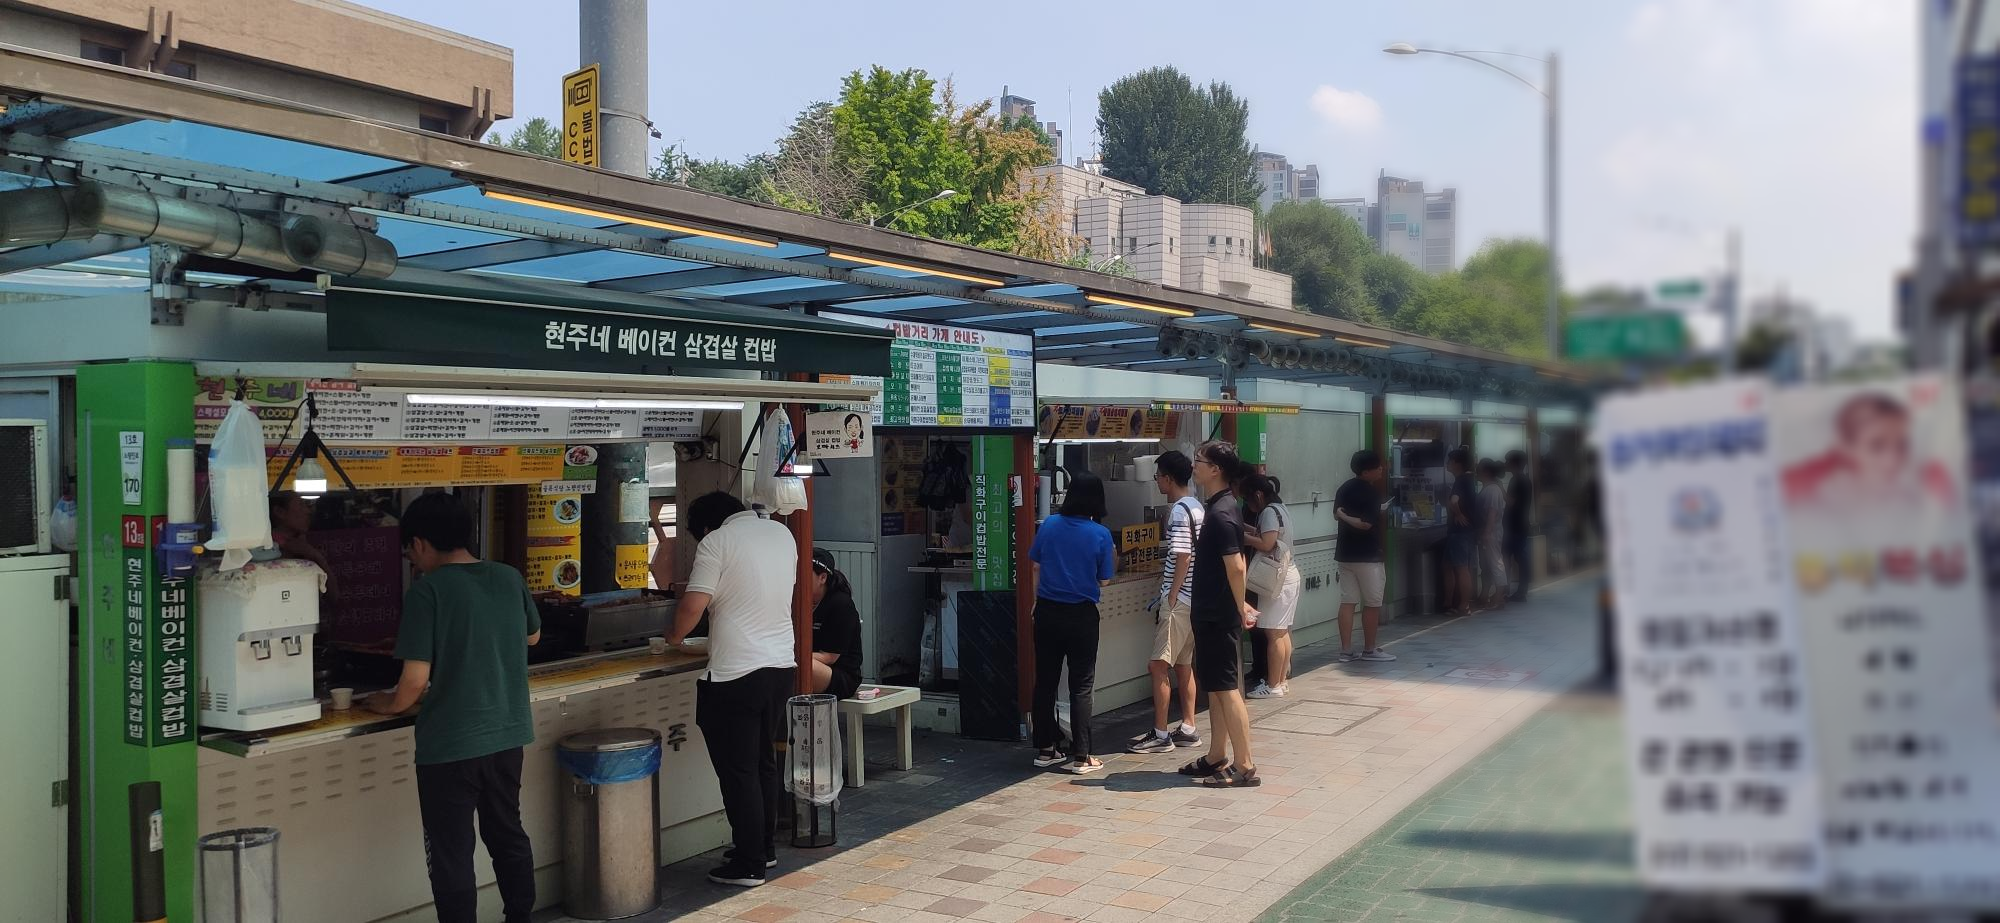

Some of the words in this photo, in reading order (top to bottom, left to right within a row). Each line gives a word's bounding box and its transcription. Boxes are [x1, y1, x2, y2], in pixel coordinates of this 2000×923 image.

[568, 121, 578, 163] CC
[544, 320, 611, 353] 현주네
[617, 326, 677, 357] 베이컨
[684, 332, 738, 361] 삼겹살
[742, 336, 777, 364] 컵밥
[932, 327, 949, 342] 가게
[953, 329, 979, 345] 안내도
[124, 478, 140, 493] 170
[1126, 527, 1155, 545] 직화구이
[160, 572, 187, 739] 주네베이컨·삼겹살컵밥
